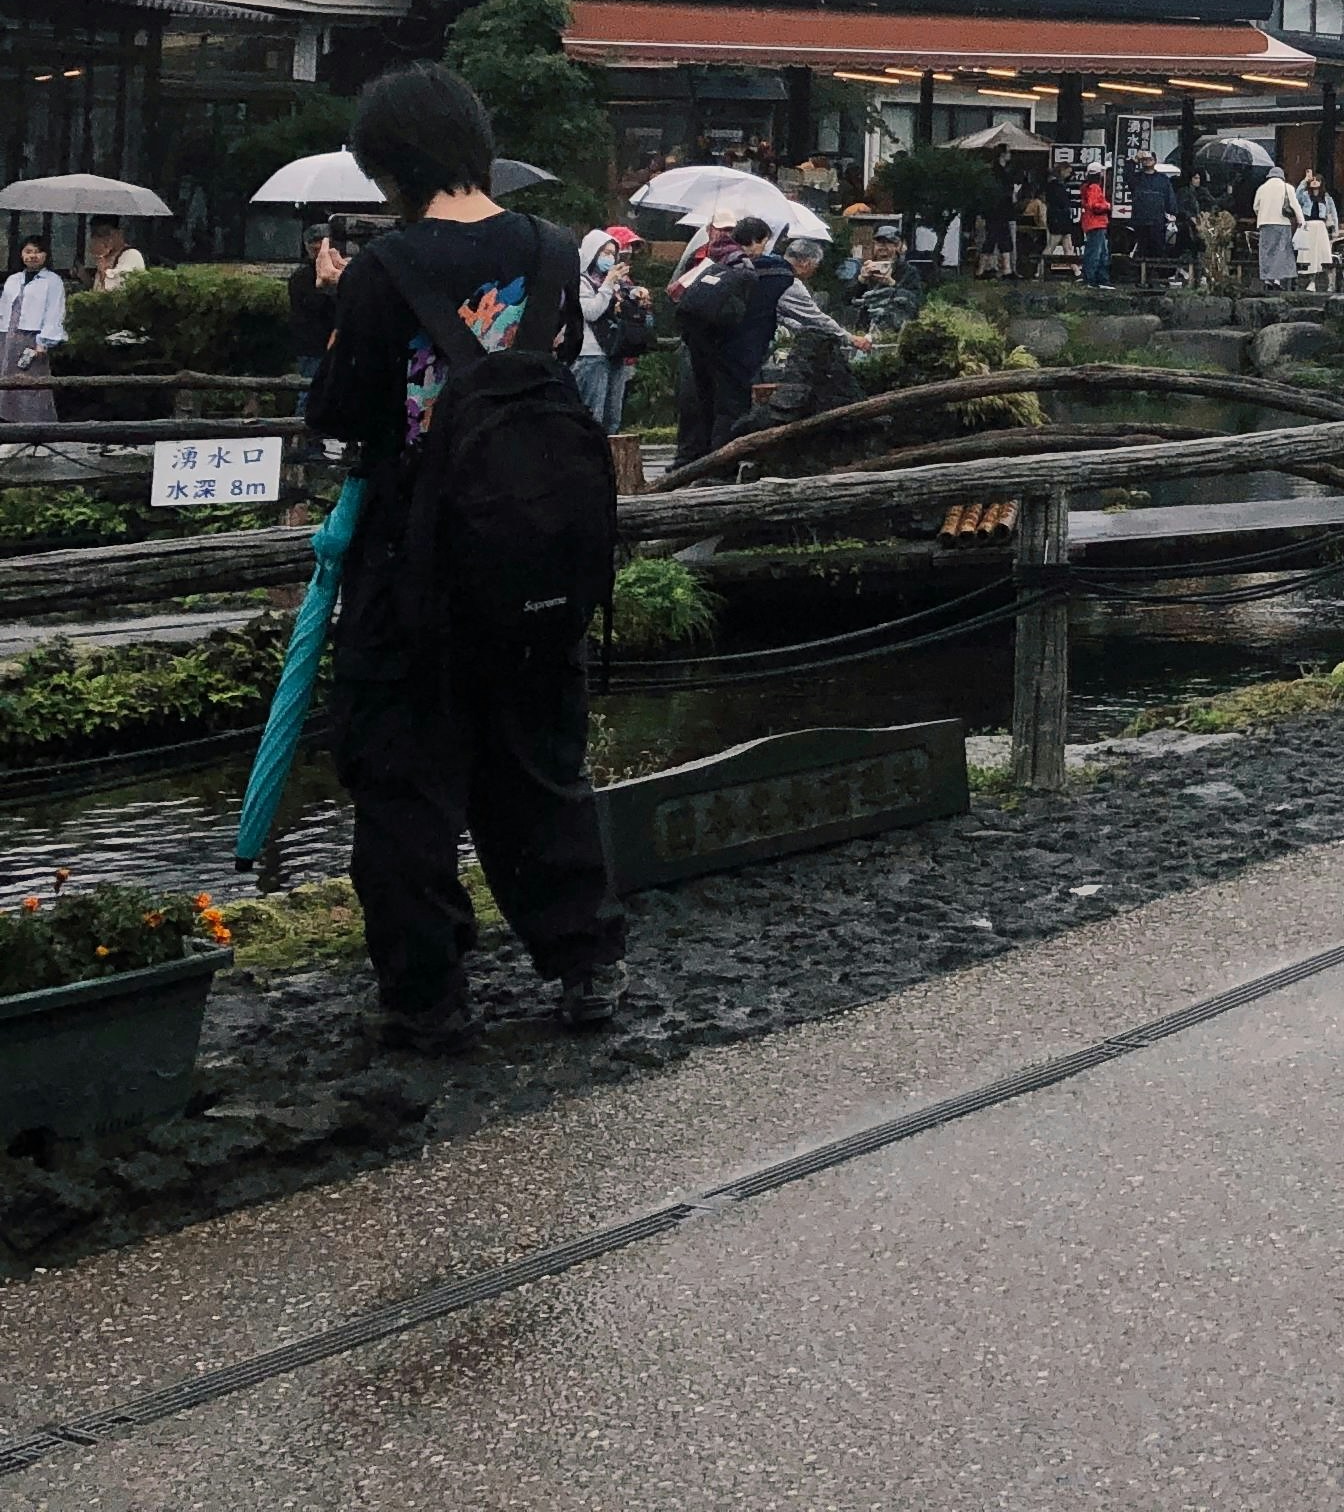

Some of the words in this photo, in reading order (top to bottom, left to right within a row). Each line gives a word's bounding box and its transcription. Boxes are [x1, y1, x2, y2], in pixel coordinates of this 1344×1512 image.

[172, 446, 264, 470] 湧水口
[166, 479, 216, 500] 水深
[230, 479, 266, 496] 8m
[524, 597, 567, 612] Supreme
